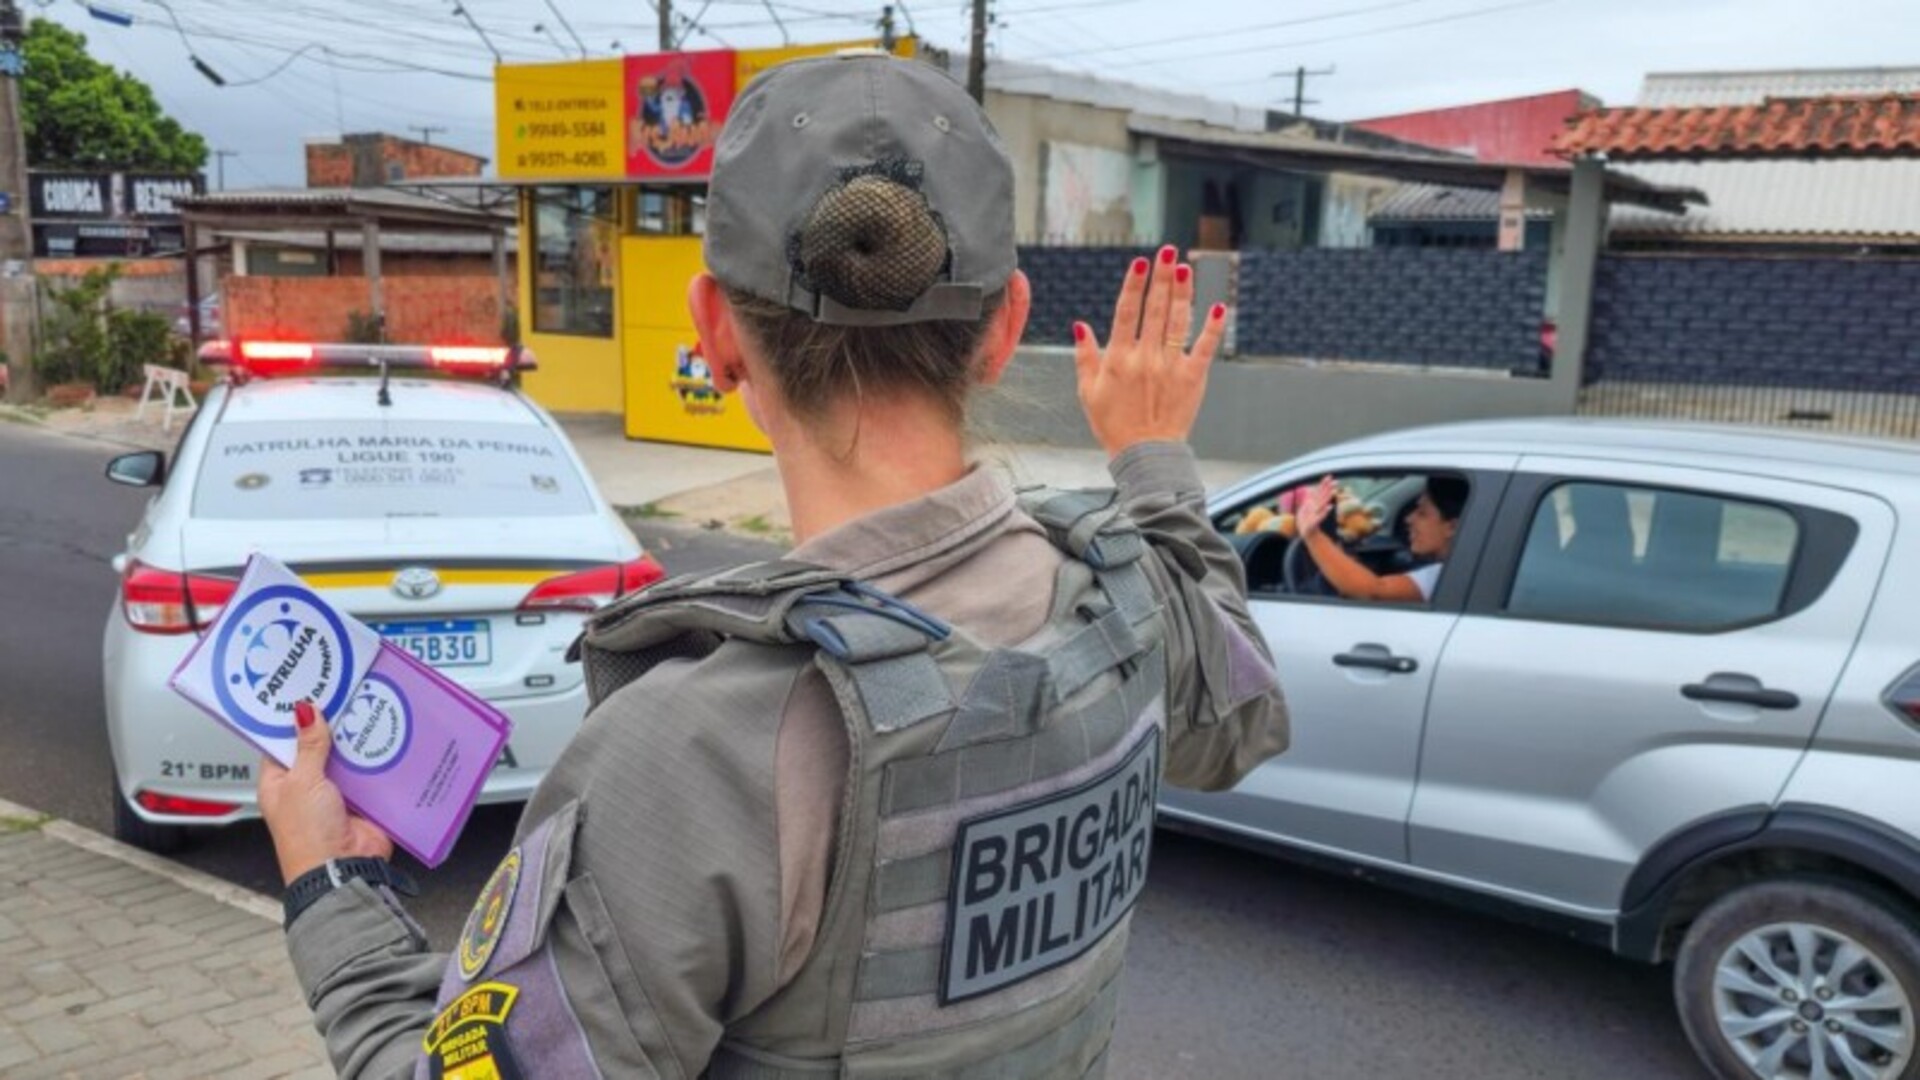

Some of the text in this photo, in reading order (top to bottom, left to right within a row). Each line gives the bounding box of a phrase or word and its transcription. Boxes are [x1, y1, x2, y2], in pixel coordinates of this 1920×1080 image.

[225, 436, 553, 457] PATRULHA MARIA DA PENHA
[337, 451, 455, 463] LIGUE 190
[256, 627, 318, 706] PATRULHA
[312, 680, 327, 699] DA
[352, 698, 388, 754] PATRULHA
[200, 763, 251, 781] BPM
[965, 757, 1151, 906] BRIGADA
[965, 828, 1147, 980] MILITAR
[460, 992, 492, 1019] BPM
[441, 1025, 489, 1055] BRIGADA
[443, 1039, 489, 1069] MILITAR
